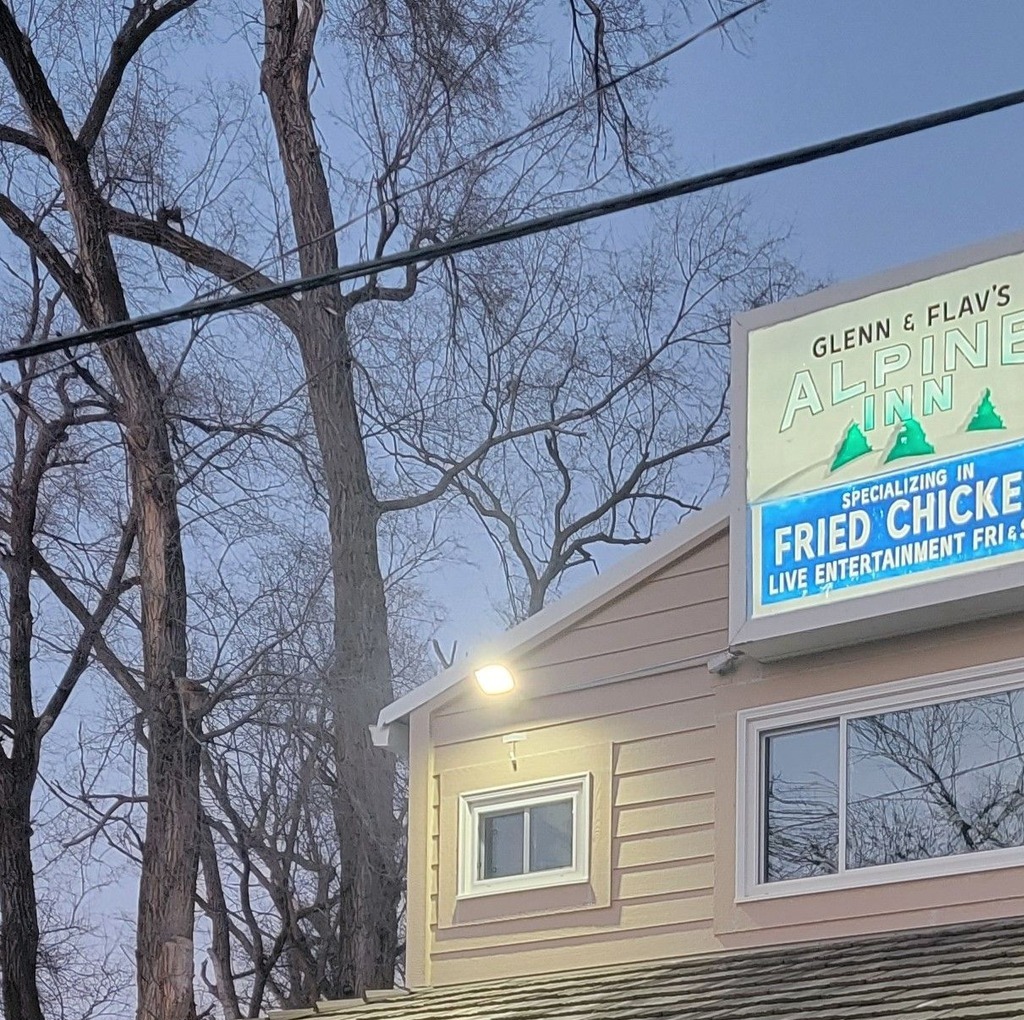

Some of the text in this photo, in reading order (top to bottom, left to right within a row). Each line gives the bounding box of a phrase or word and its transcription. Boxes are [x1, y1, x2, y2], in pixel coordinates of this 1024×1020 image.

[812, 284, 1011, 358] GLENN & FLAV'S
[864, 374, 954, 432] INN
[842, 462, 975, 509] SPECIALIZING IN
[769, 567, 808, 595] LIVE
[815, 532, 966, 584] ENTERTAINMENT
[972, 522, 1004, 550] FRI
[1007, 525, 1017, 541] &
[774, 509, 871, 566] FRIED
